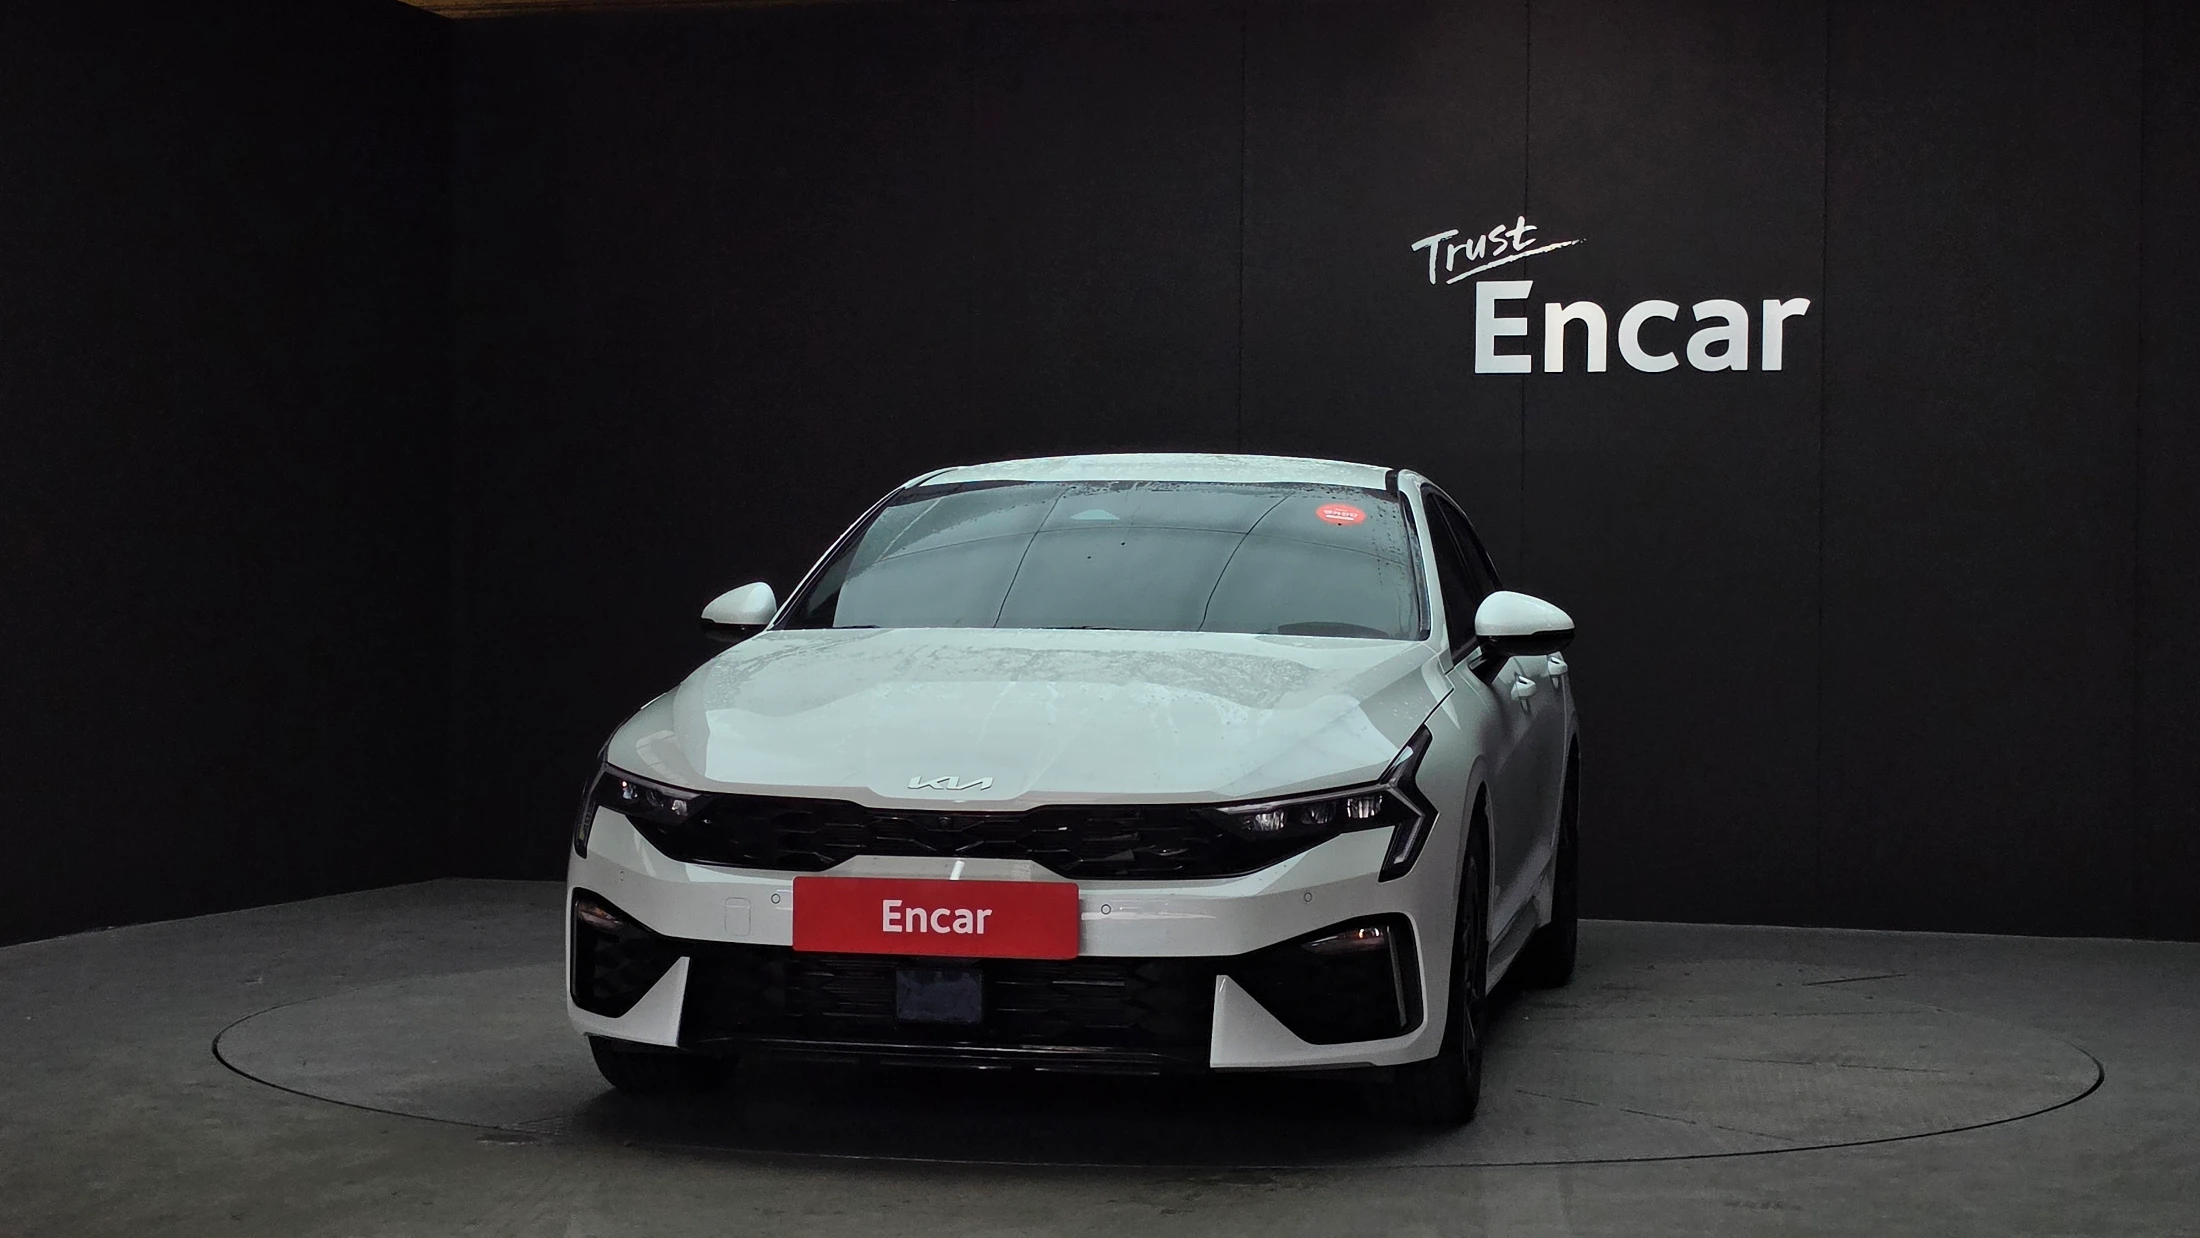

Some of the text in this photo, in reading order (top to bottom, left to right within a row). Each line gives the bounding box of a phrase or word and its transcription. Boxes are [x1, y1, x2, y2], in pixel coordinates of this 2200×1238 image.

[1411, 215, 1538, 285] Trust
[1474, 279, 1811, 374] Encar
[881, 899, 993, 934] Encar
